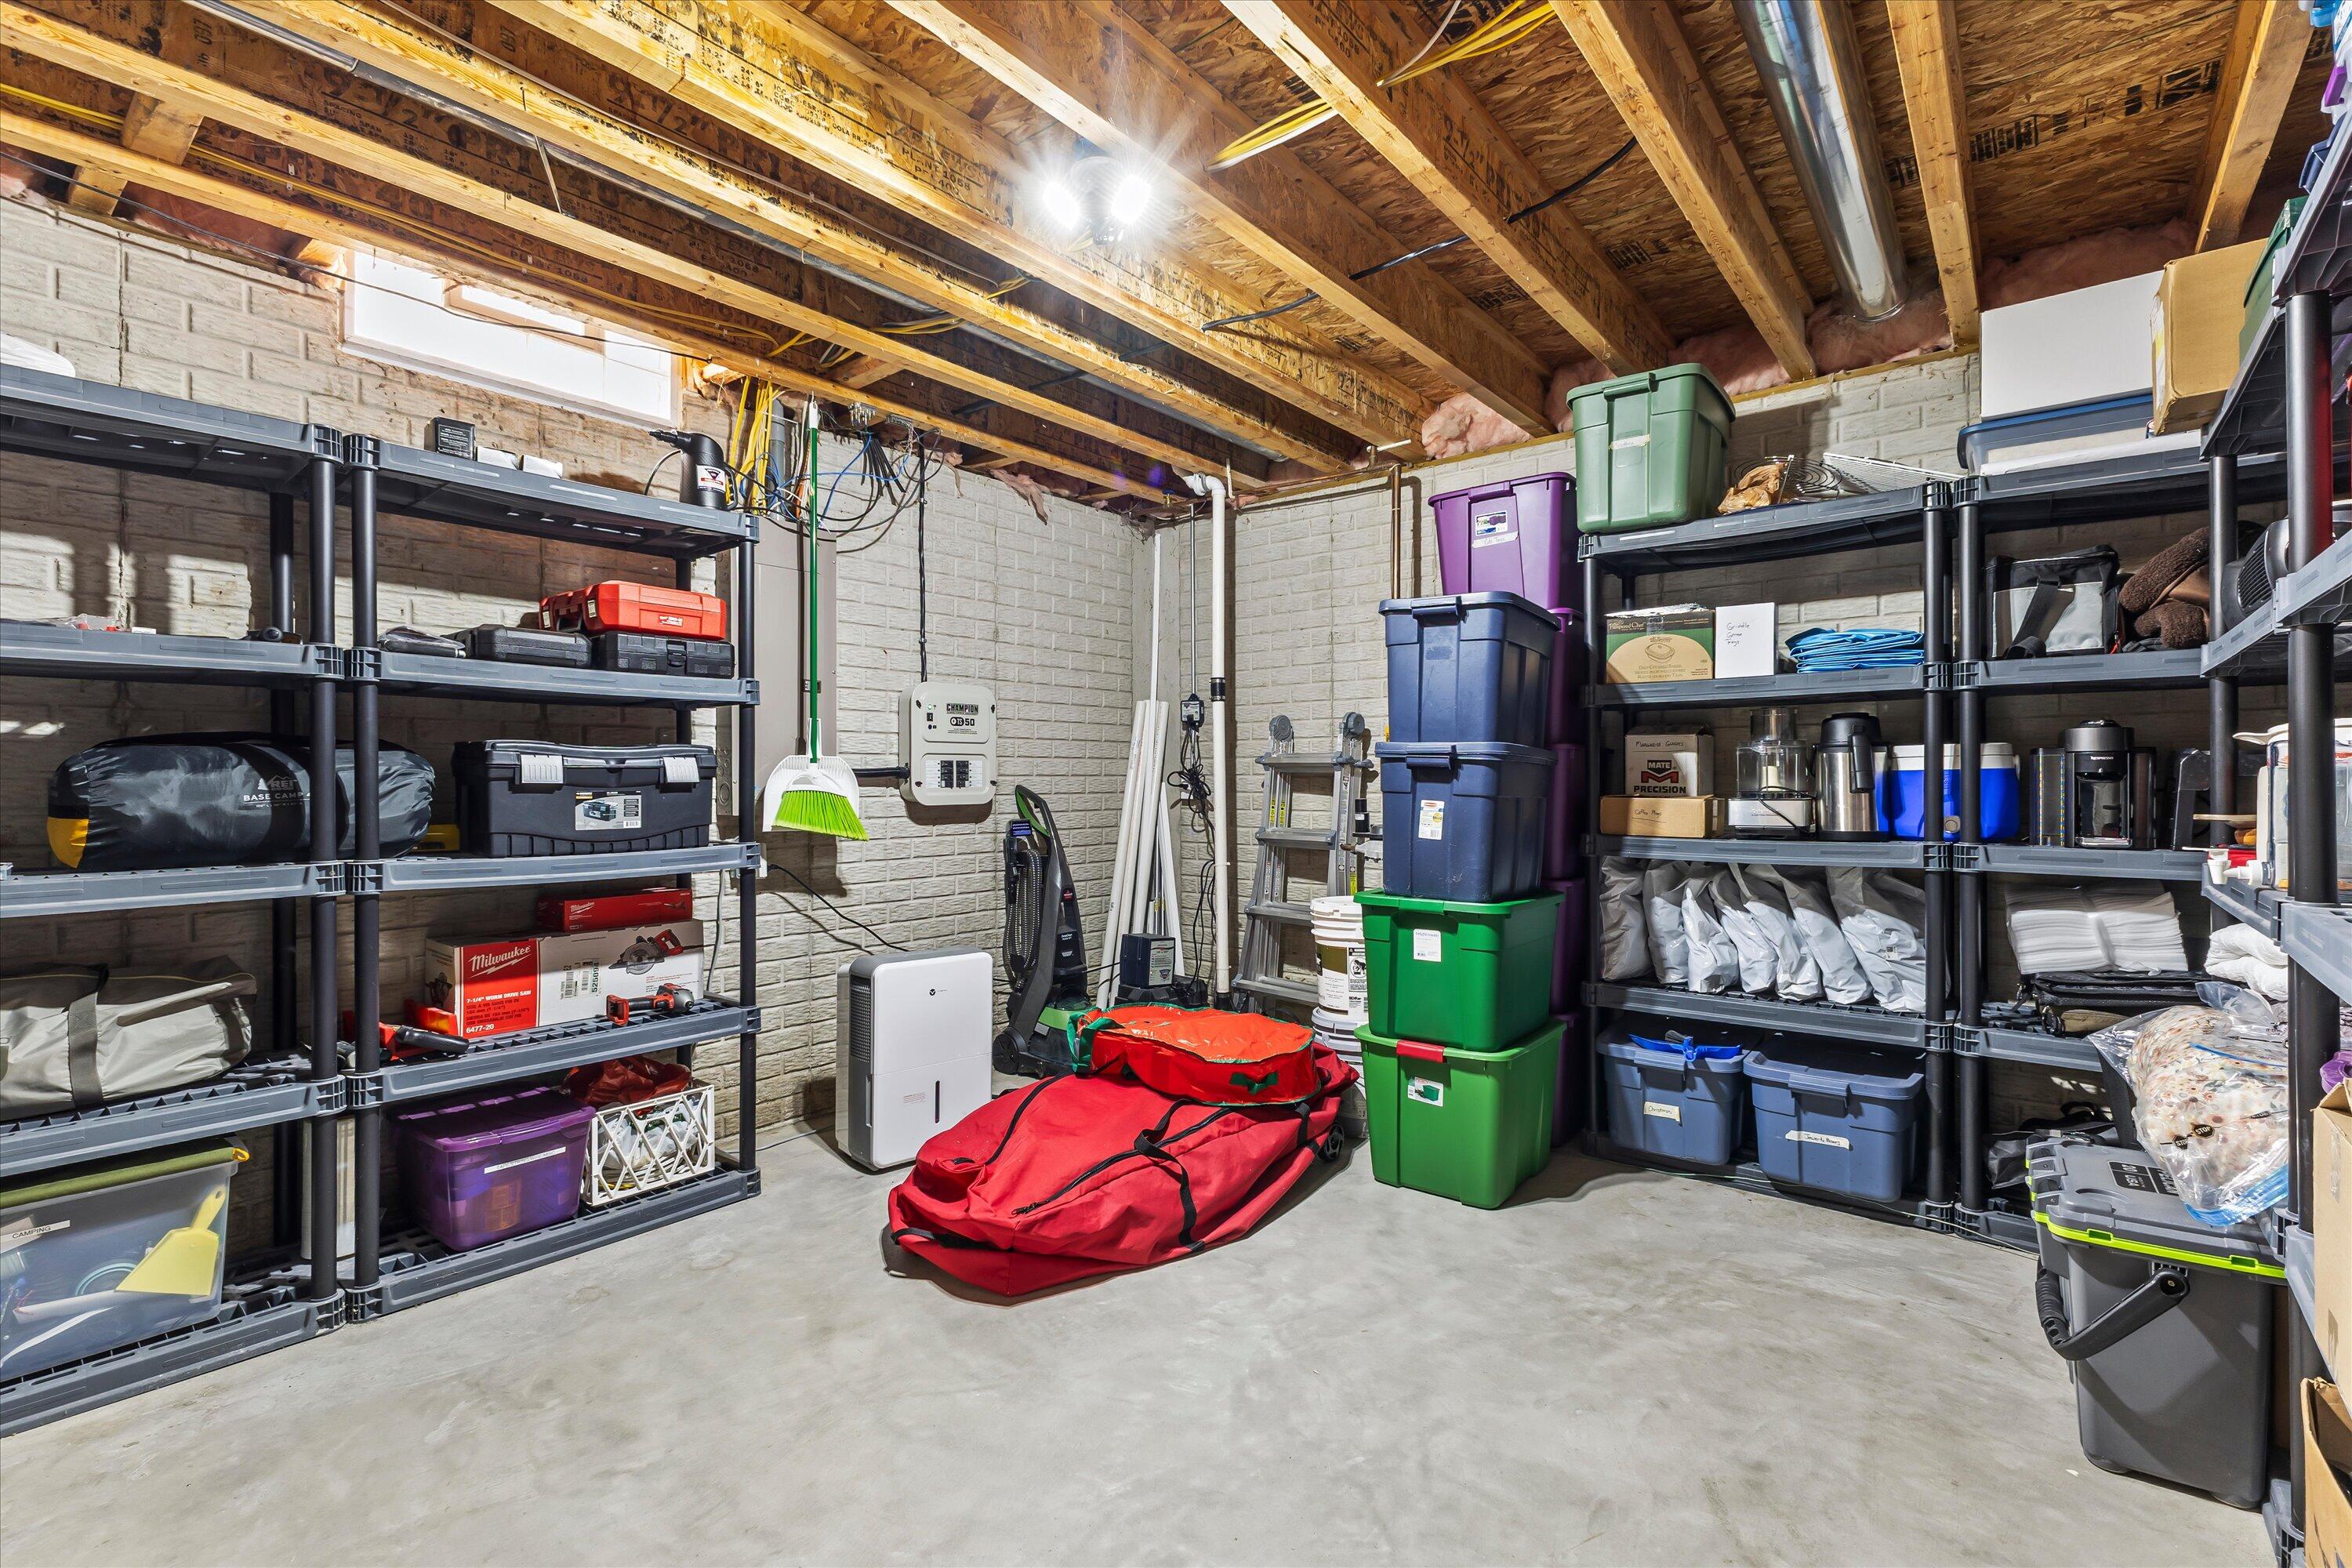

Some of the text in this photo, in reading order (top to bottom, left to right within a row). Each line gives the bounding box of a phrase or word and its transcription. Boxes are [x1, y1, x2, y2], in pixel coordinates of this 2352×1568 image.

[946, 703, 978, 713] CHAMPION
[468, 945, 532, 972] Milwaukee
[466, 1023, 495, 1033] 6477-20
[13, 1225, 51, 1239] CAMPING
